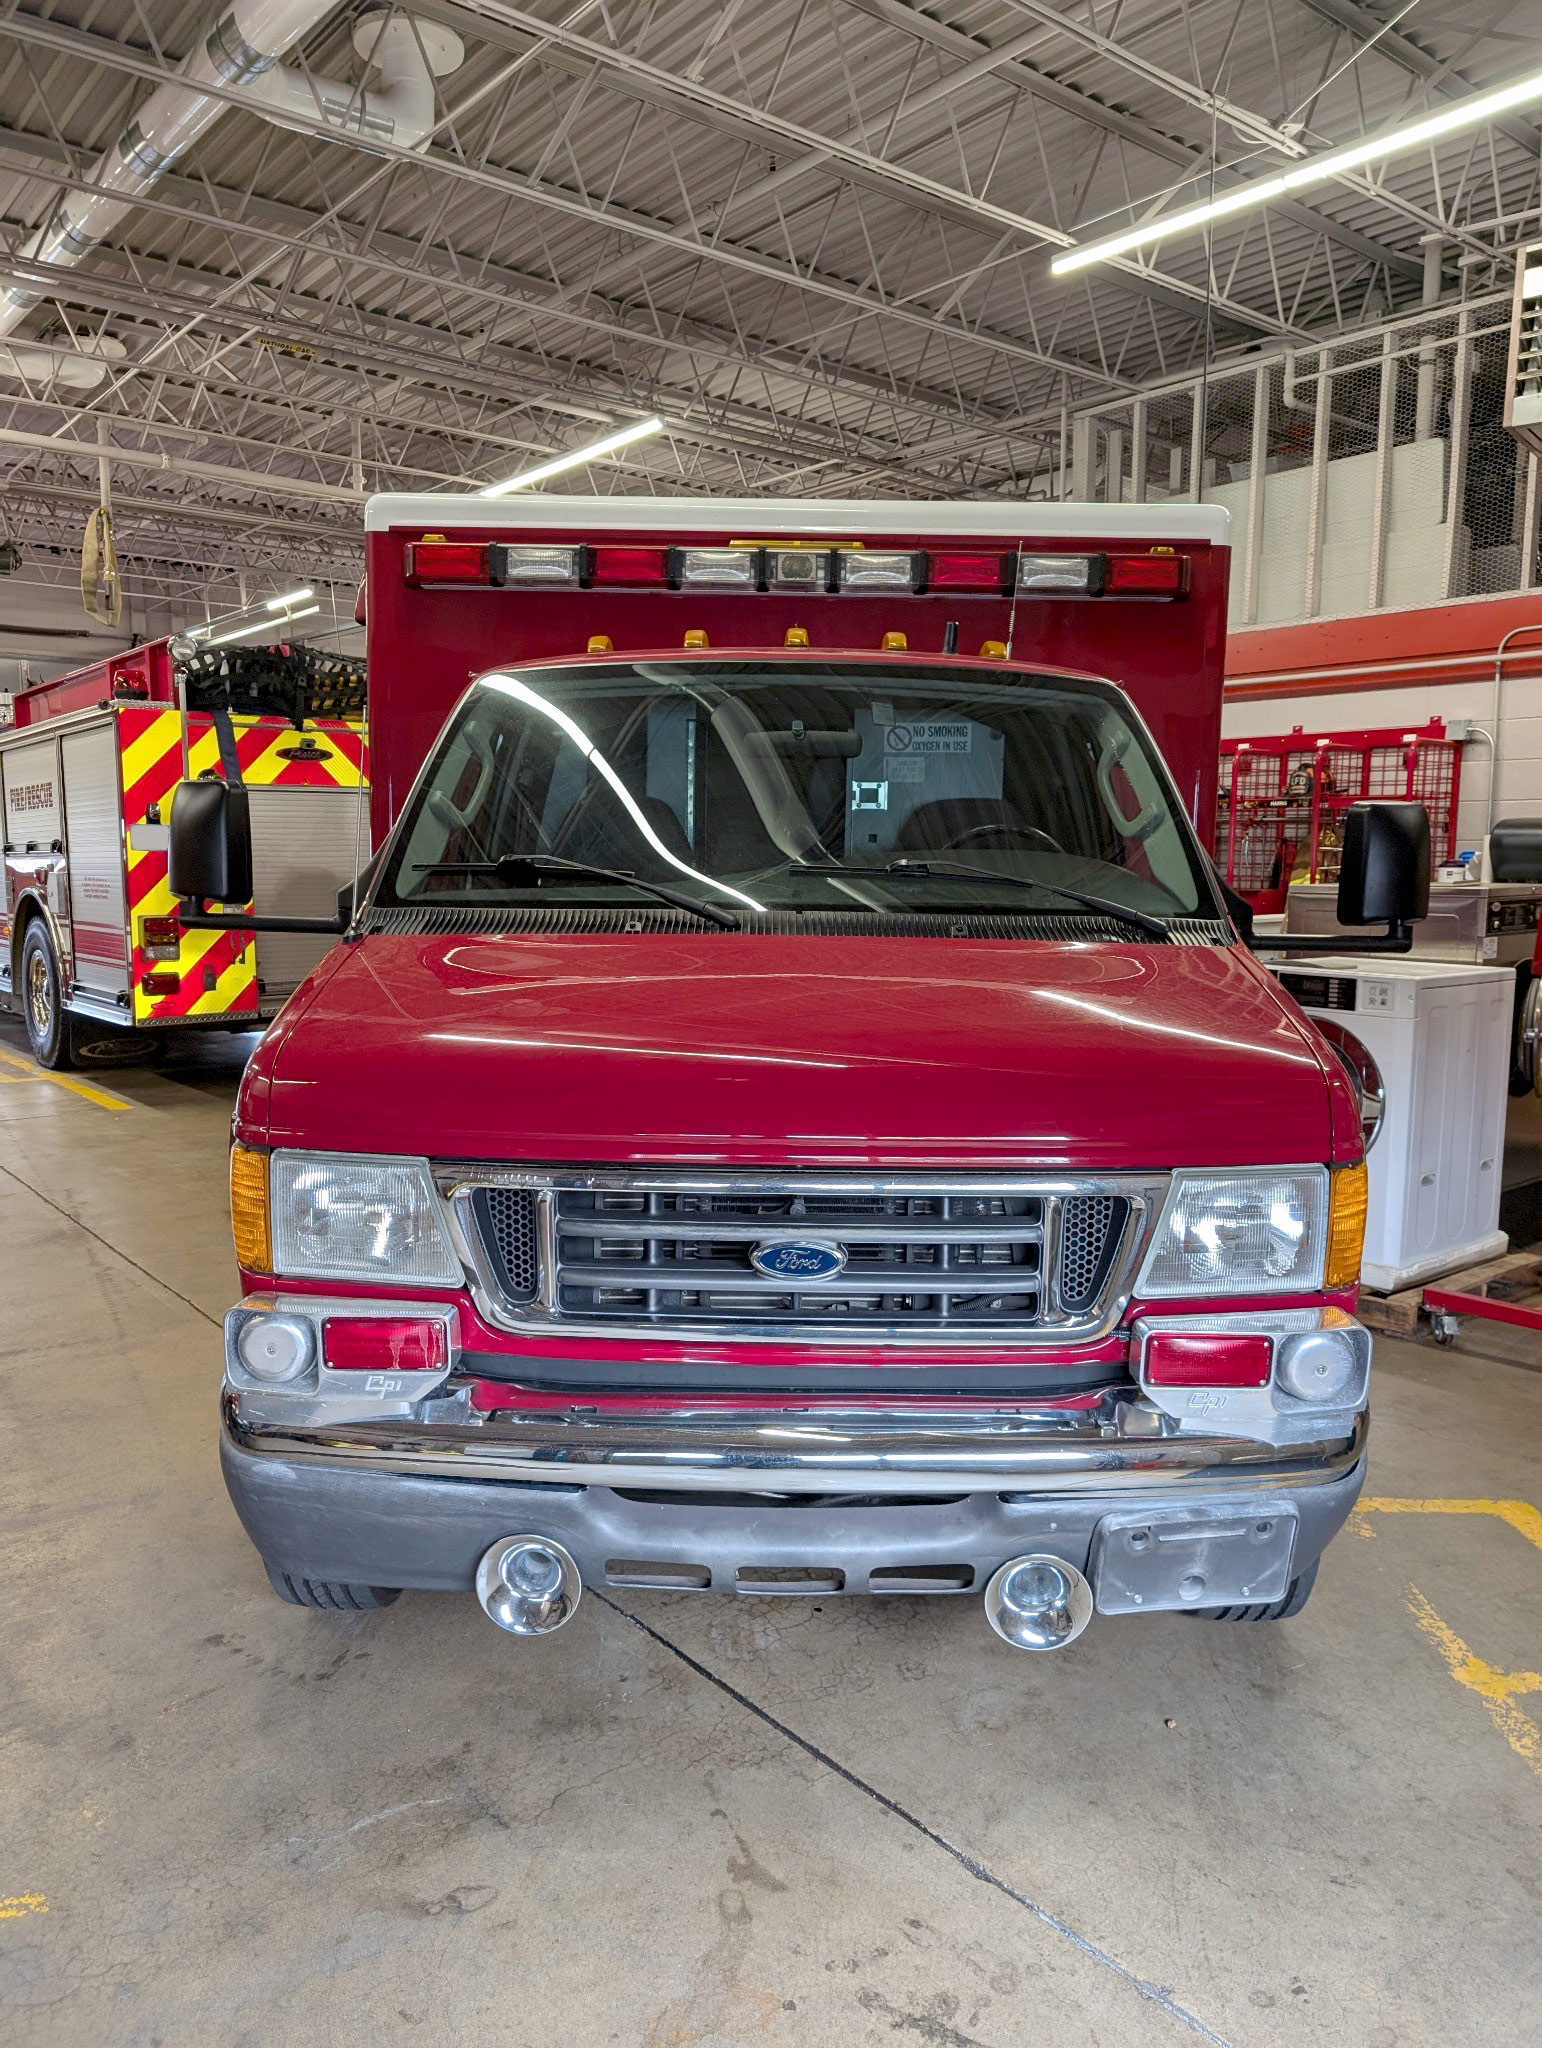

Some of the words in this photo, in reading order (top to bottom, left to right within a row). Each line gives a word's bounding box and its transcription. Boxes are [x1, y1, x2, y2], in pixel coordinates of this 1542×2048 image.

[912, 725, 925, 738] NO
[928, 725, 968, 738] SMOKING
[912, 741, 940, 752] OXYGEN
[943, 741, 951, 751] IN
[953, 741, 968, 751] USE
[10, 781, 53, 812] FIRE/RESCUE
[775, 1249, 822, 1270] Ford
